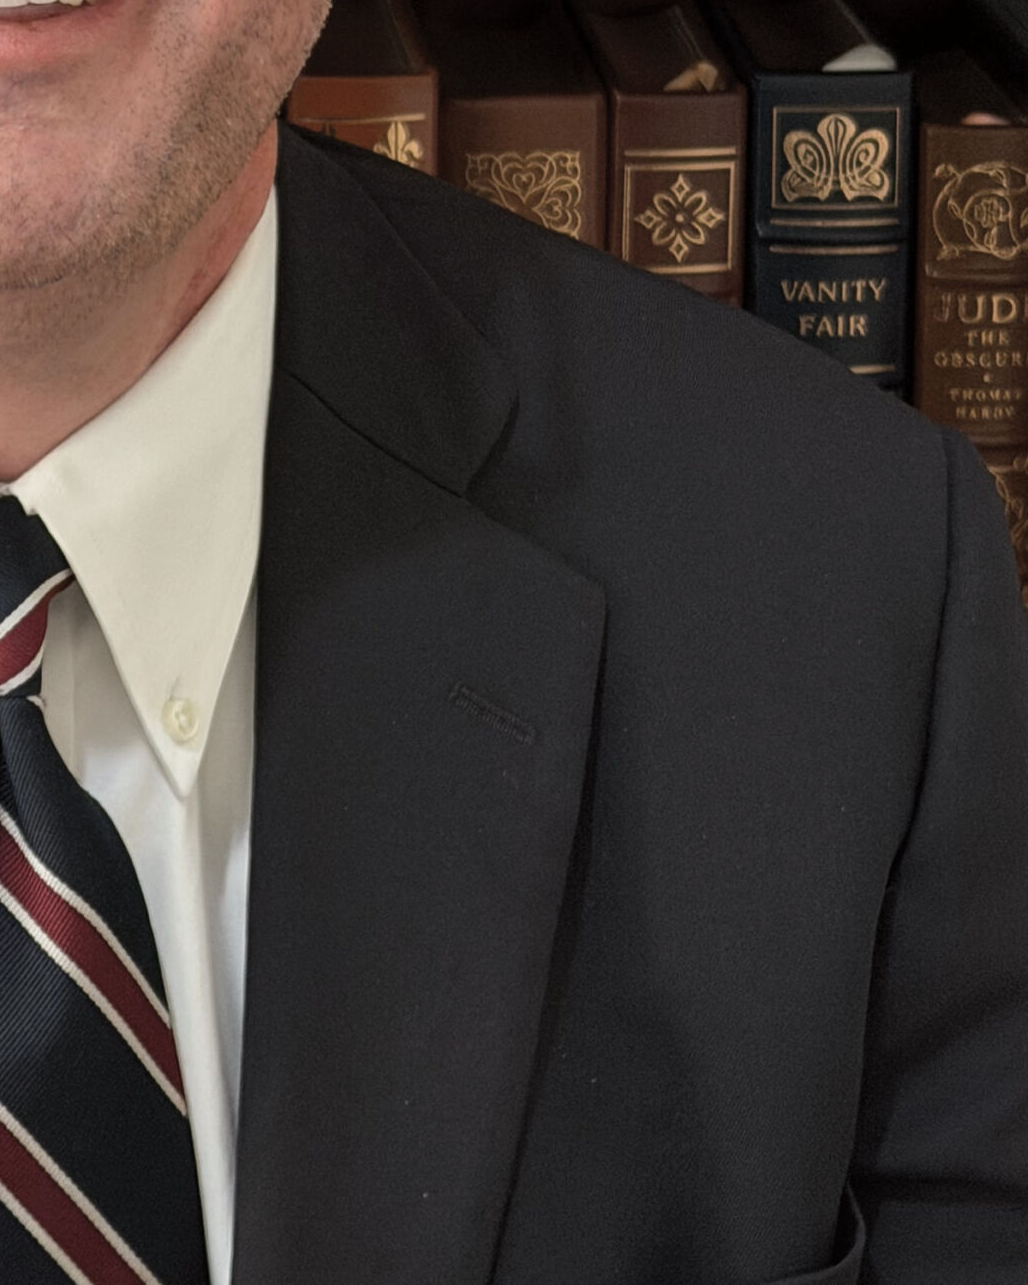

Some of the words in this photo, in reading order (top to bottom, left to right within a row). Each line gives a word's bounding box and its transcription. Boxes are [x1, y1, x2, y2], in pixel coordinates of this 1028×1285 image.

[780, 277, 886, 303] VANITY
[932, 292, 1028, 323] JUD
[799, 313, 866, 338] FAIR
[965, 329, 1010, 346] THE
[933, 351, 1028, 368] OBSCUR
